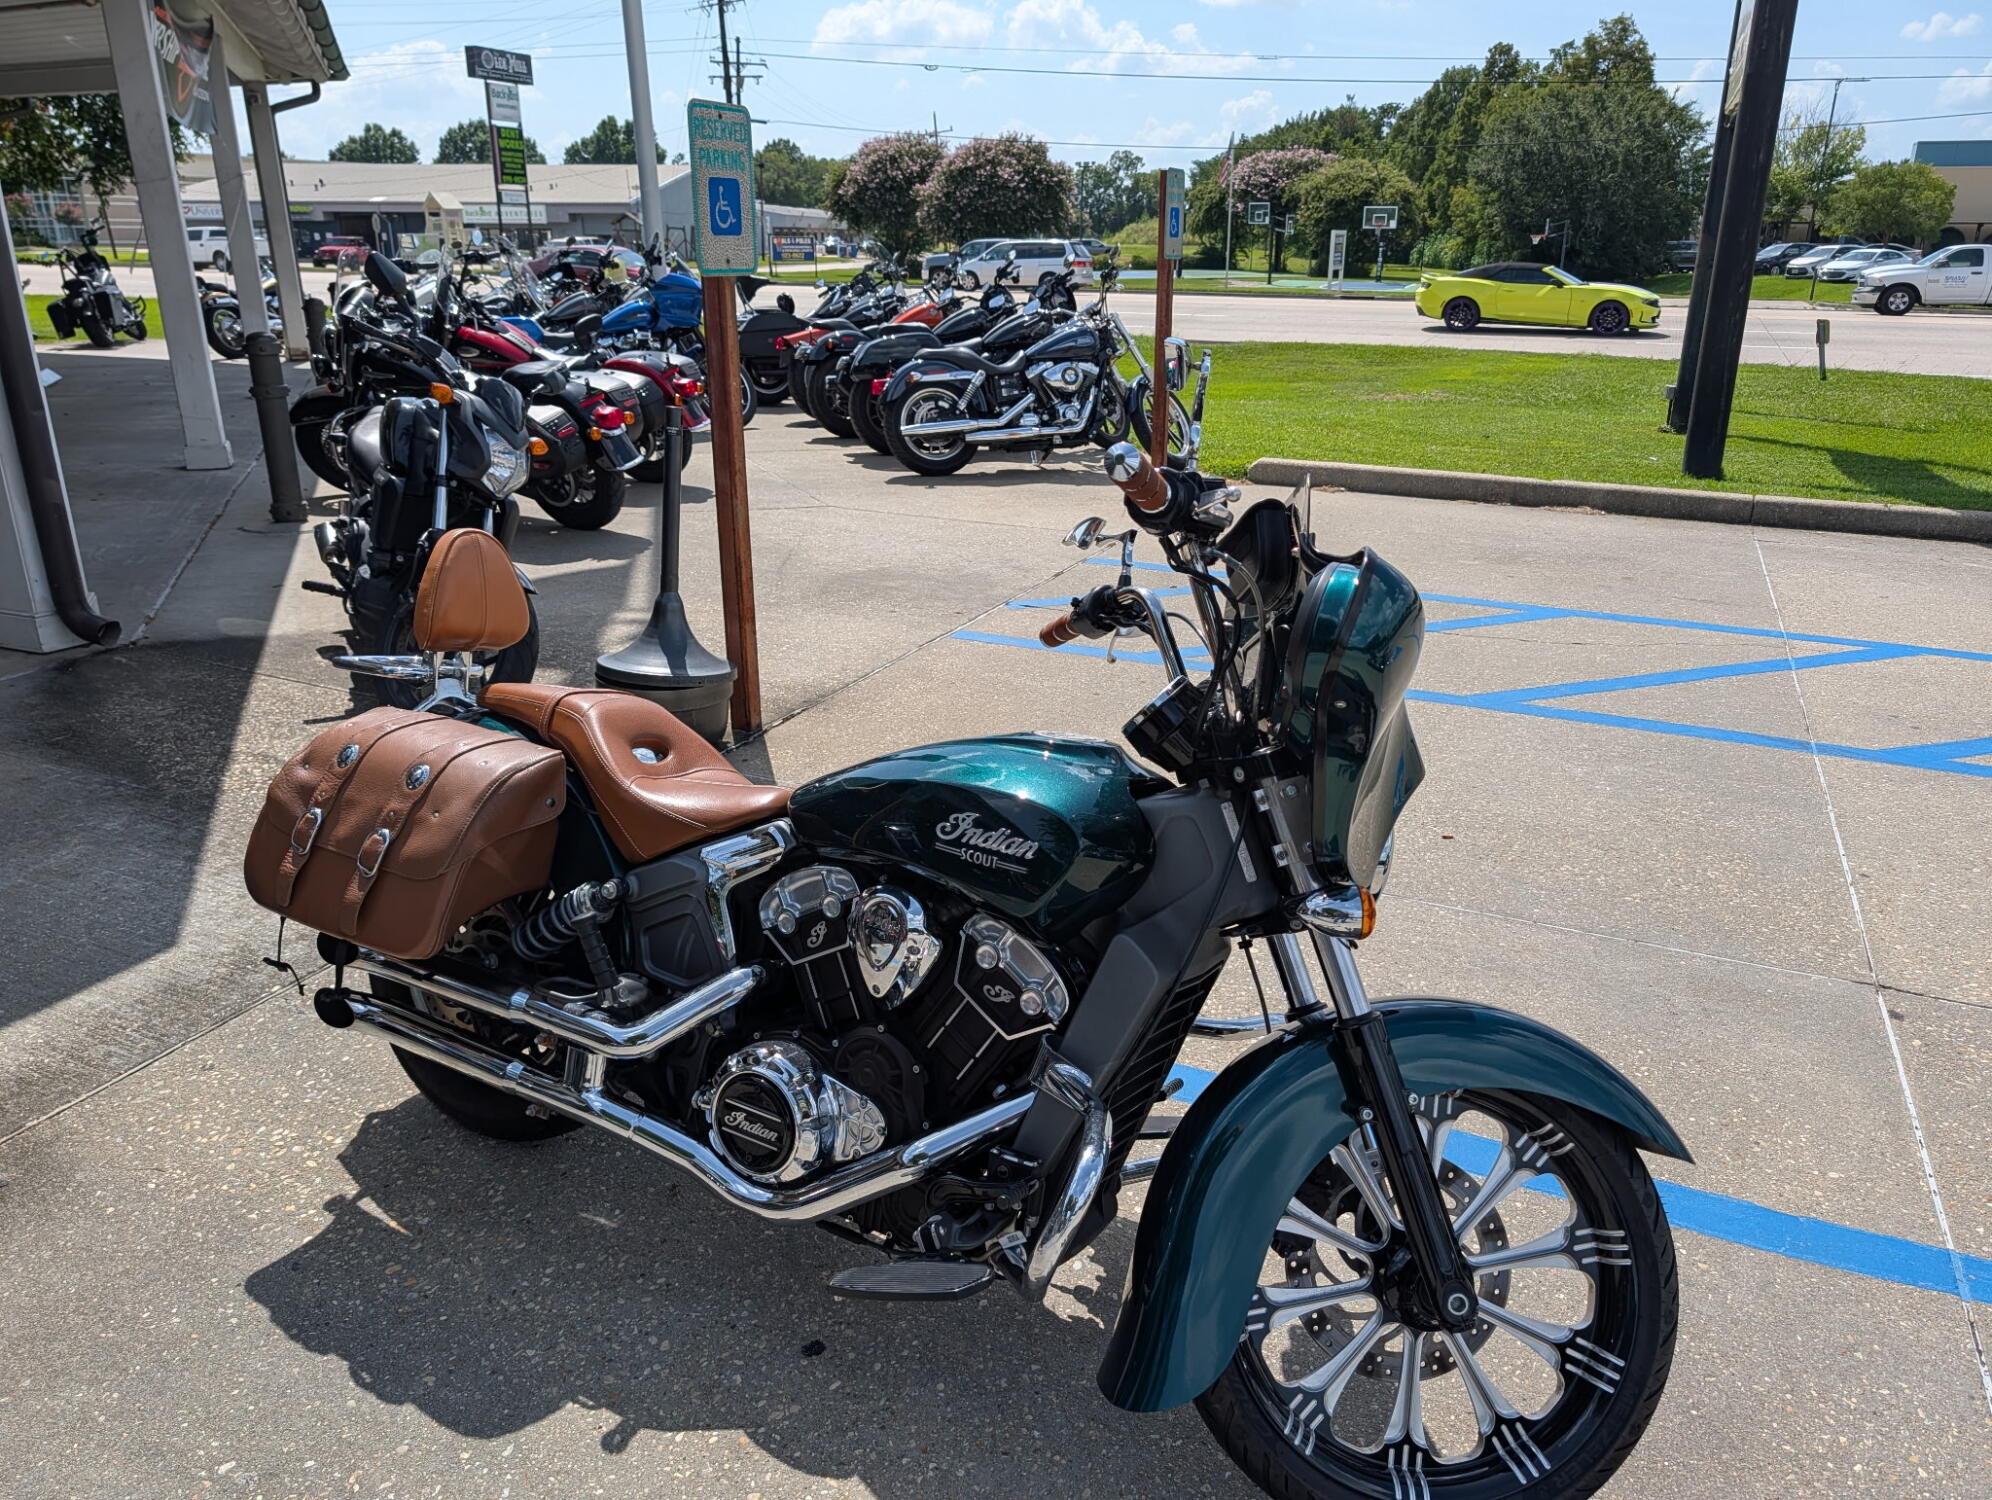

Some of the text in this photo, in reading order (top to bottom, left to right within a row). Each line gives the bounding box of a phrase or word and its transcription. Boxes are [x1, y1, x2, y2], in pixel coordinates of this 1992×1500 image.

[500, 128, 520, 139] DENT
[691, 117, 749, 143] RESERVED
[499, 139, 525, 150] WORKS
[699, 147, 746, 172] PARKING
[936, 812, 1039, 860] Indian
[960, 848, 999, 869] SCOUT
[724, 1111, 778, 1141] Indian
